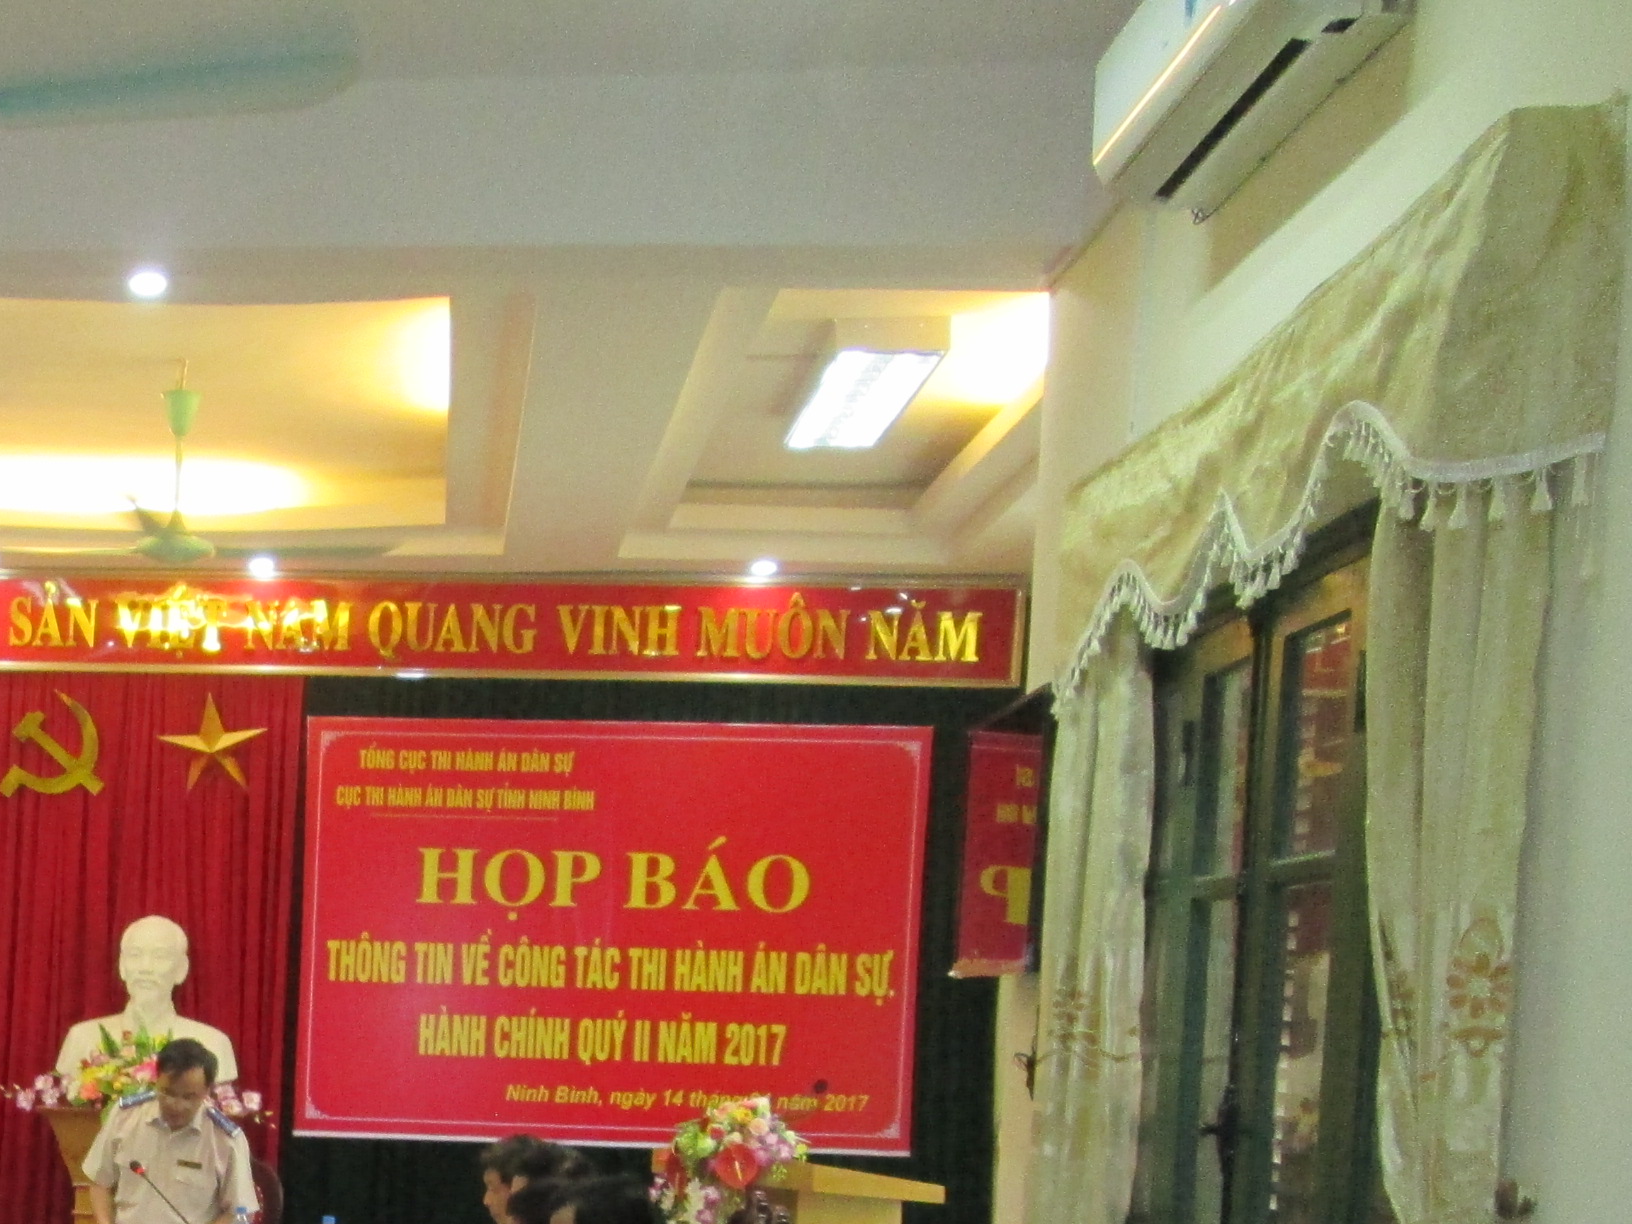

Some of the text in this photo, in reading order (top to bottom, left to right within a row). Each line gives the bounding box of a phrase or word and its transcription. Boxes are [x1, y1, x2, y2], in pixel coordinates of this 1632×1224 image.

[8, 581, 97, 648] SẢN
[117, 582, 228, 659] VIỆT
[244, 598, 353, 653] NAM
[368, 600, 537, 659] QUANG
[556, 604, 683, 656] VINH
[696, 592, 851, 660] MUÔN
[865, 599, 983, 662] NĂM
[360, 741, 575, 777] TỔNG CỤC THI HÀNH ÁN DÂN SỰ
[336, 782, 595, 813] CỤC THI HÀNH ÁN DÂN SỰ TỈNH NINH BÌNH
[416, 835, 810, 921] HỌP BÁO
[327, 931, 407, 983] THÔNG
[415, 942, 454, 984] TIN
[462, 929, 492, 986] VỀ
[498, 935, 567, 988] CÔNG
[574, 937, 621, 989] TÁC
[628, 947, 667, 990] THI
[674, 940, 744, 992] HÀNH
[751, 941, 788, 994] ÁN
[794, 943, 848, 995] DÂN
[418, 1004, 788, 1066] HÀNH CHÍNH QUÝ II NĂM 2017
[506, 1084, 550, 1102] Ninh
[555, 1085, 603, 1106] Bình,
[610, 1088, 657, 1111] ngày
[663, 1089, 684, 1106] 14
[824, 1094, 869, 1112] 2017
